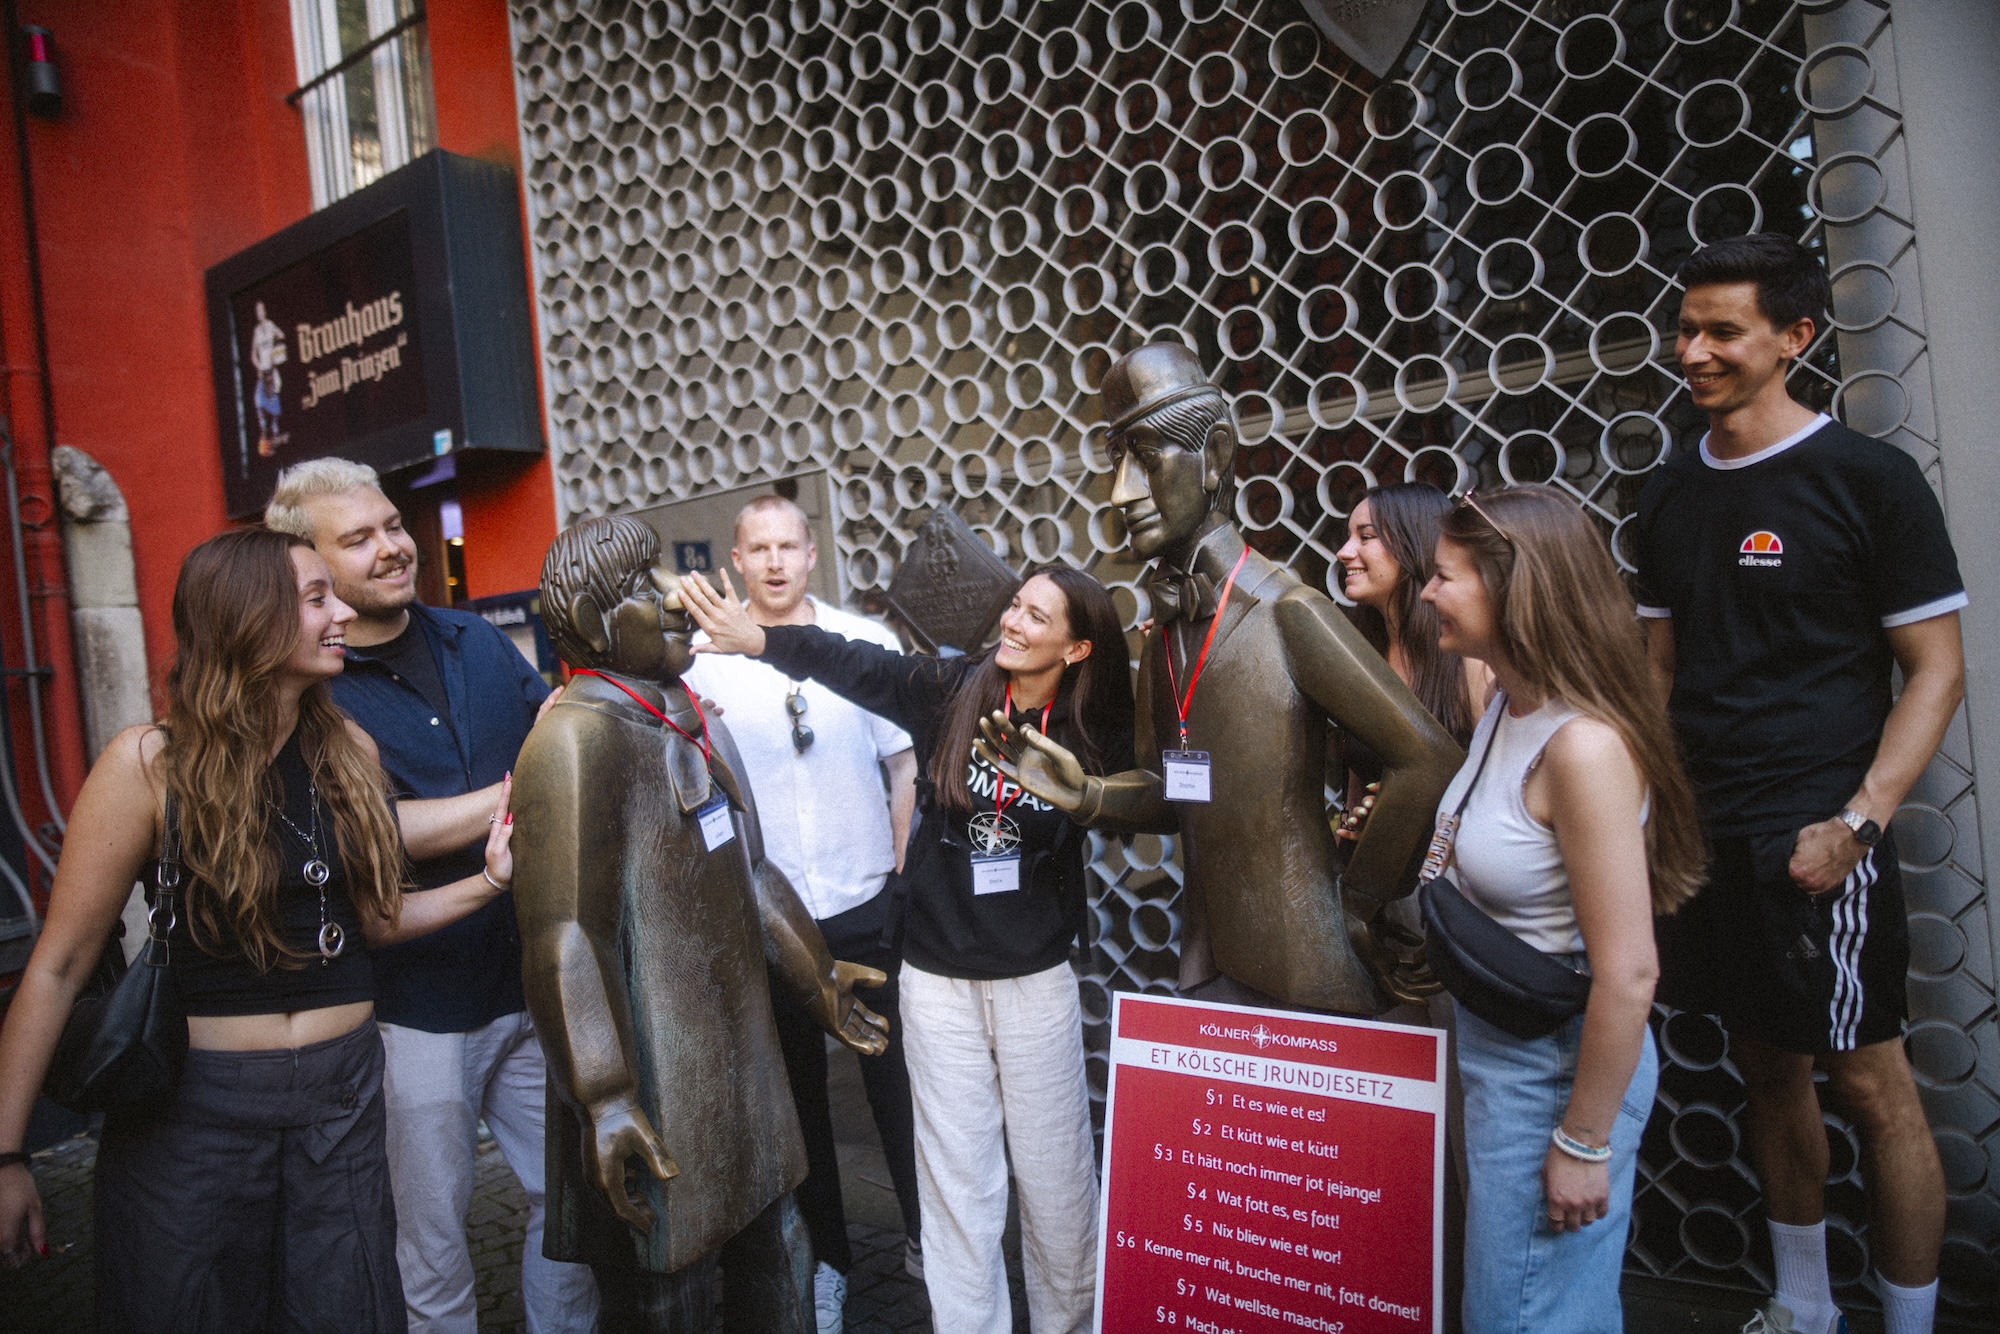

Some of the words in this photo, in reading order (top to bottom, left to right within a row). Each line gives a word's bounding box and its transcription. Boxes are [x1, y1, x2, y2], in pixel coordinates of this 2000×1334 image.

[297, 290, 403, 363] Brauhaus
[1738, 555, 1782, 567] ellesse
[1200, 1023, 1250, 1041] KÖLNER
[1272, 1033, 1337, 1052] KOMPASS
[1151, 1048, 1171, 1065] ET
[1177, 1050, 1257, 1079] KÖLSCHE
[1263, 1064, 1393, 1100] JRUNDJESETZ
[1233, 1094, 1245, 1109] Et
[1248, 1100, 1263, 1112] es
[1266, 1101, 1288, 1116] wie
[1290, 1106, 1305, 1119] et
[1307, 1108, 1326, 1123] es!
[1221, 1125, 1234, 1140] Et
[1237, 1127, 1263, 1146] kütt
[1266, 1134, 1288, 1150] wie
[1290, 1140, 1305, 1154] et
[1307, 1140, 1339, 1159] kütt!
[1182, 1150, 1194, 1165] Et
[1197, 1152, 1223, 1171] hätt
[1226, 1162, 1257, 1177] noch
[1259, 1165, 1302, 1187] immer
[1305, 1174, 1324, 1192] jot
[1327, 1178, 1381, 1204] jejange!
[1216, 1189, 1242, 1208] Wat
[1245, 1196, 1269, 1214] fott
[1272, 1204, 1290, 1220] es,
[1292, 1209, 1308, 1222] es
[1311, 1209, 1340, 1229] fott!
[1213, 1221, 1233, 1239] Nix
[1236, 1226, 1267, 1246] bliev
[1269, 1237, 1292, 1253] wie
[1295, 1243, 1309, 1257] et
[1312, 1248, 1342, 1265] wor!
[1144, 1238, 1183, 1260] Kenne
[1186, 1251, 1211, 1266] mer
[1213, 1256, 1233, 1275] nit,
[1236, 1260, 1282, 1285] bruche
[1284, 1276, 1312, 1293] mer
[1314, 1282, 1336, 1301] nit,
[1339, 1286, 1365, 1305] fott
[1368, 1295, 1420, 1321] domet!
[1185, 1315, 1219, 1334] Mach
[1205, 1286, 1231, 1307] Wat
[1234, 1297, 1281, 1320] wellste
[1283, 1309, 1344, 1334] maache?
